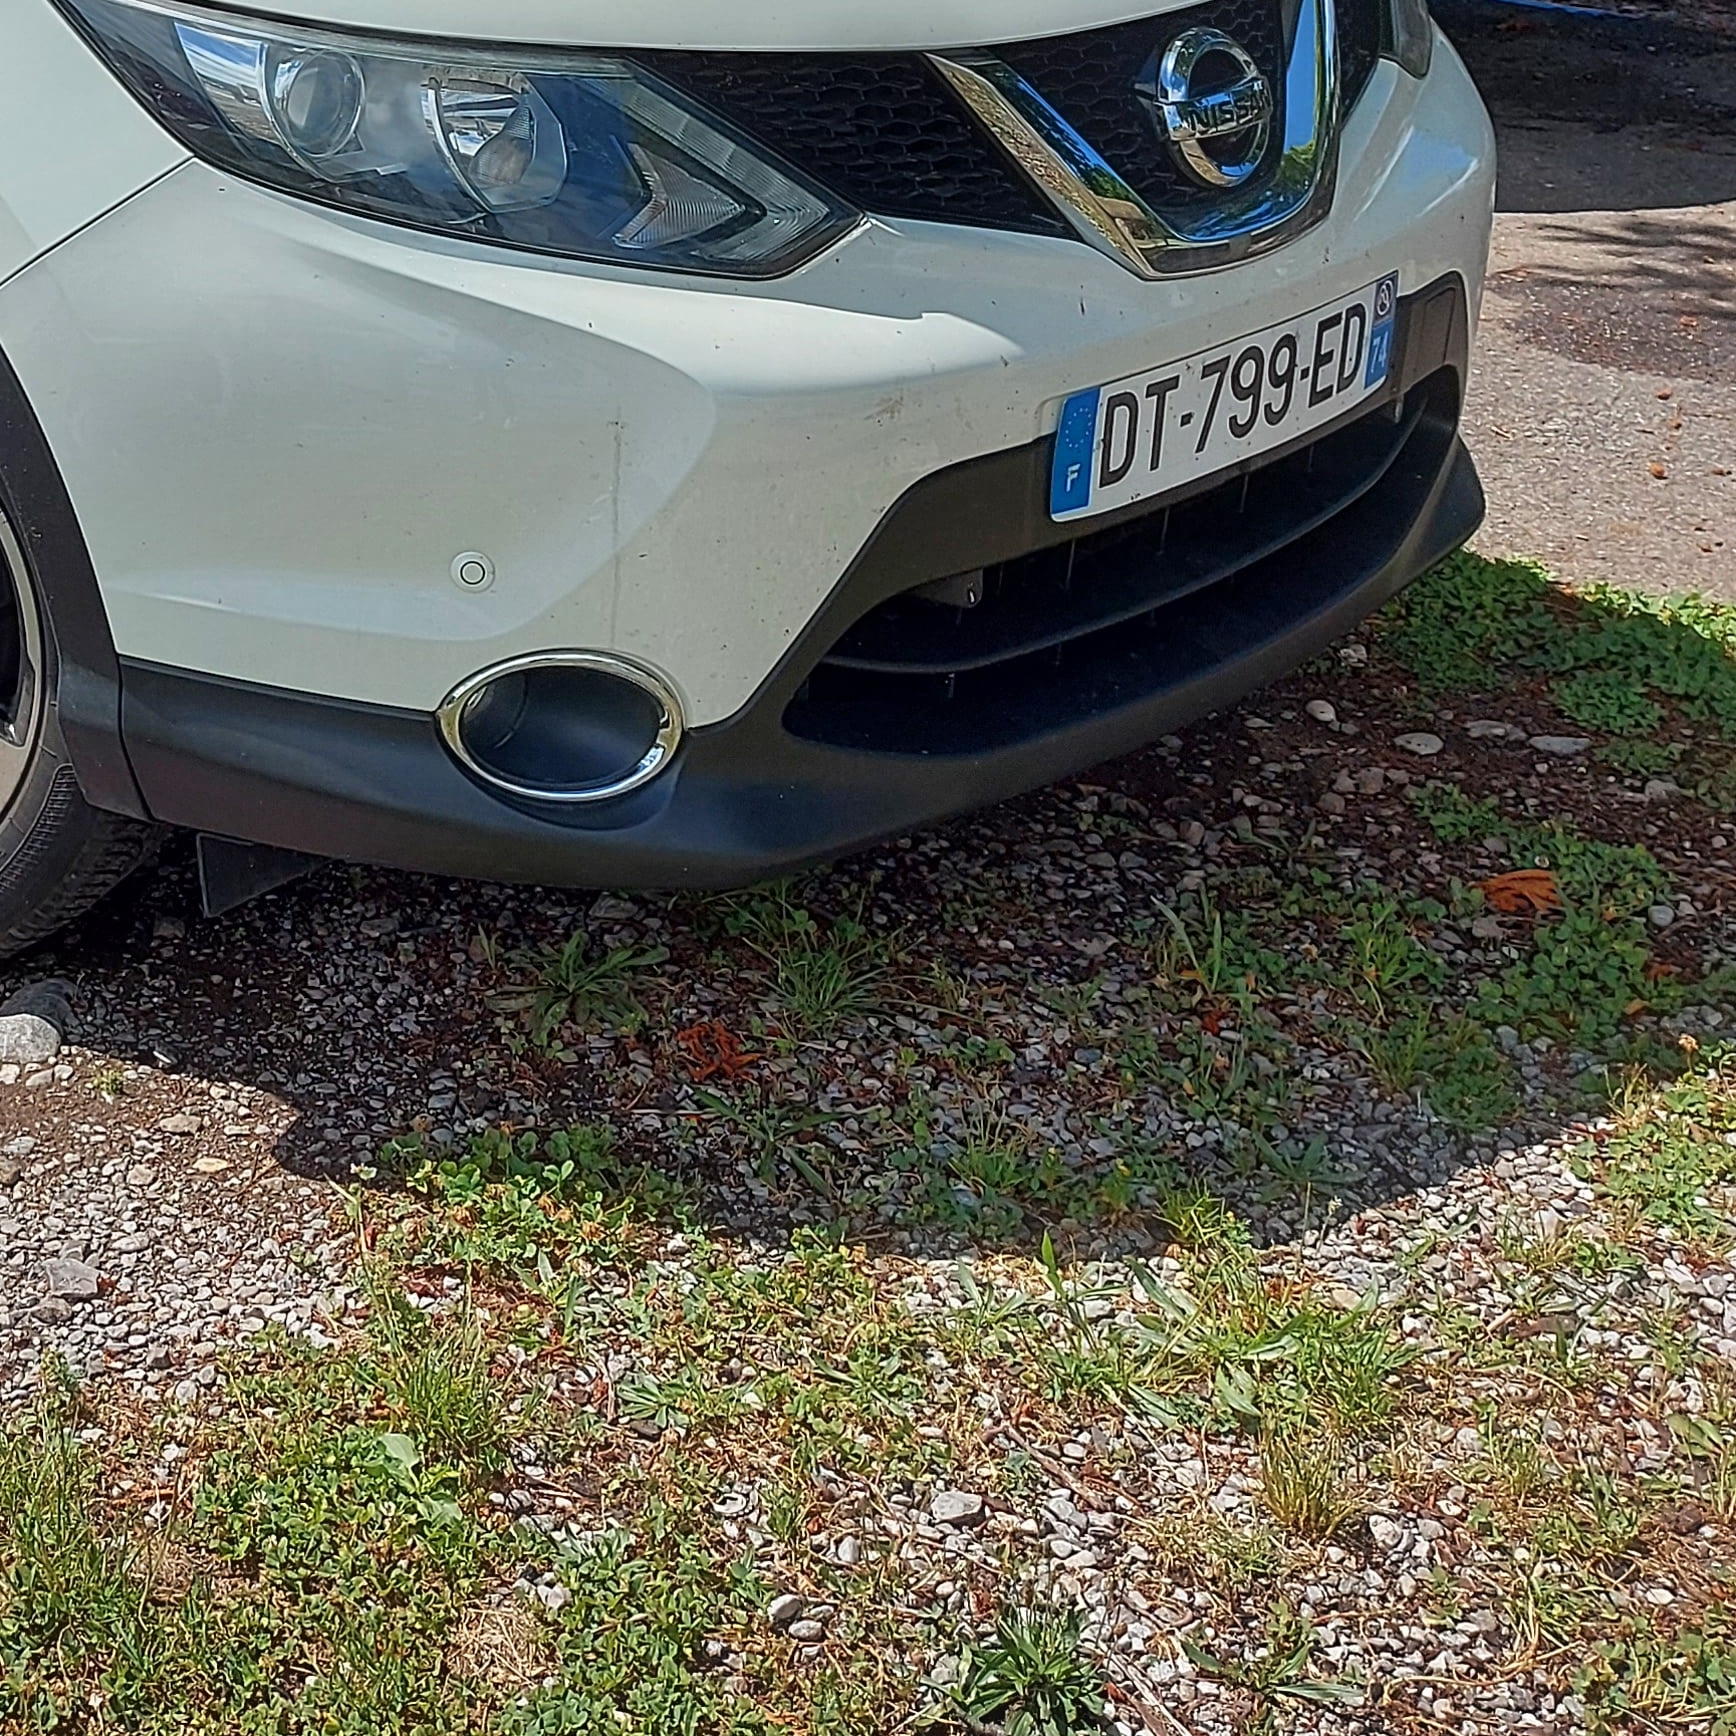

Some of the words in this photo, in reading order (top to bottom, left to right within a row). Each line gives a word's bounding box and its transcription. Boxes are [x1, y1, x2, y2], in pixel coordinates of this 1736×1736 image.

[1065, 464, 1080, 492] F
[1098, 301, 1369, 489] DT-799-ED
[1370, 330, 1390, 373] 74
